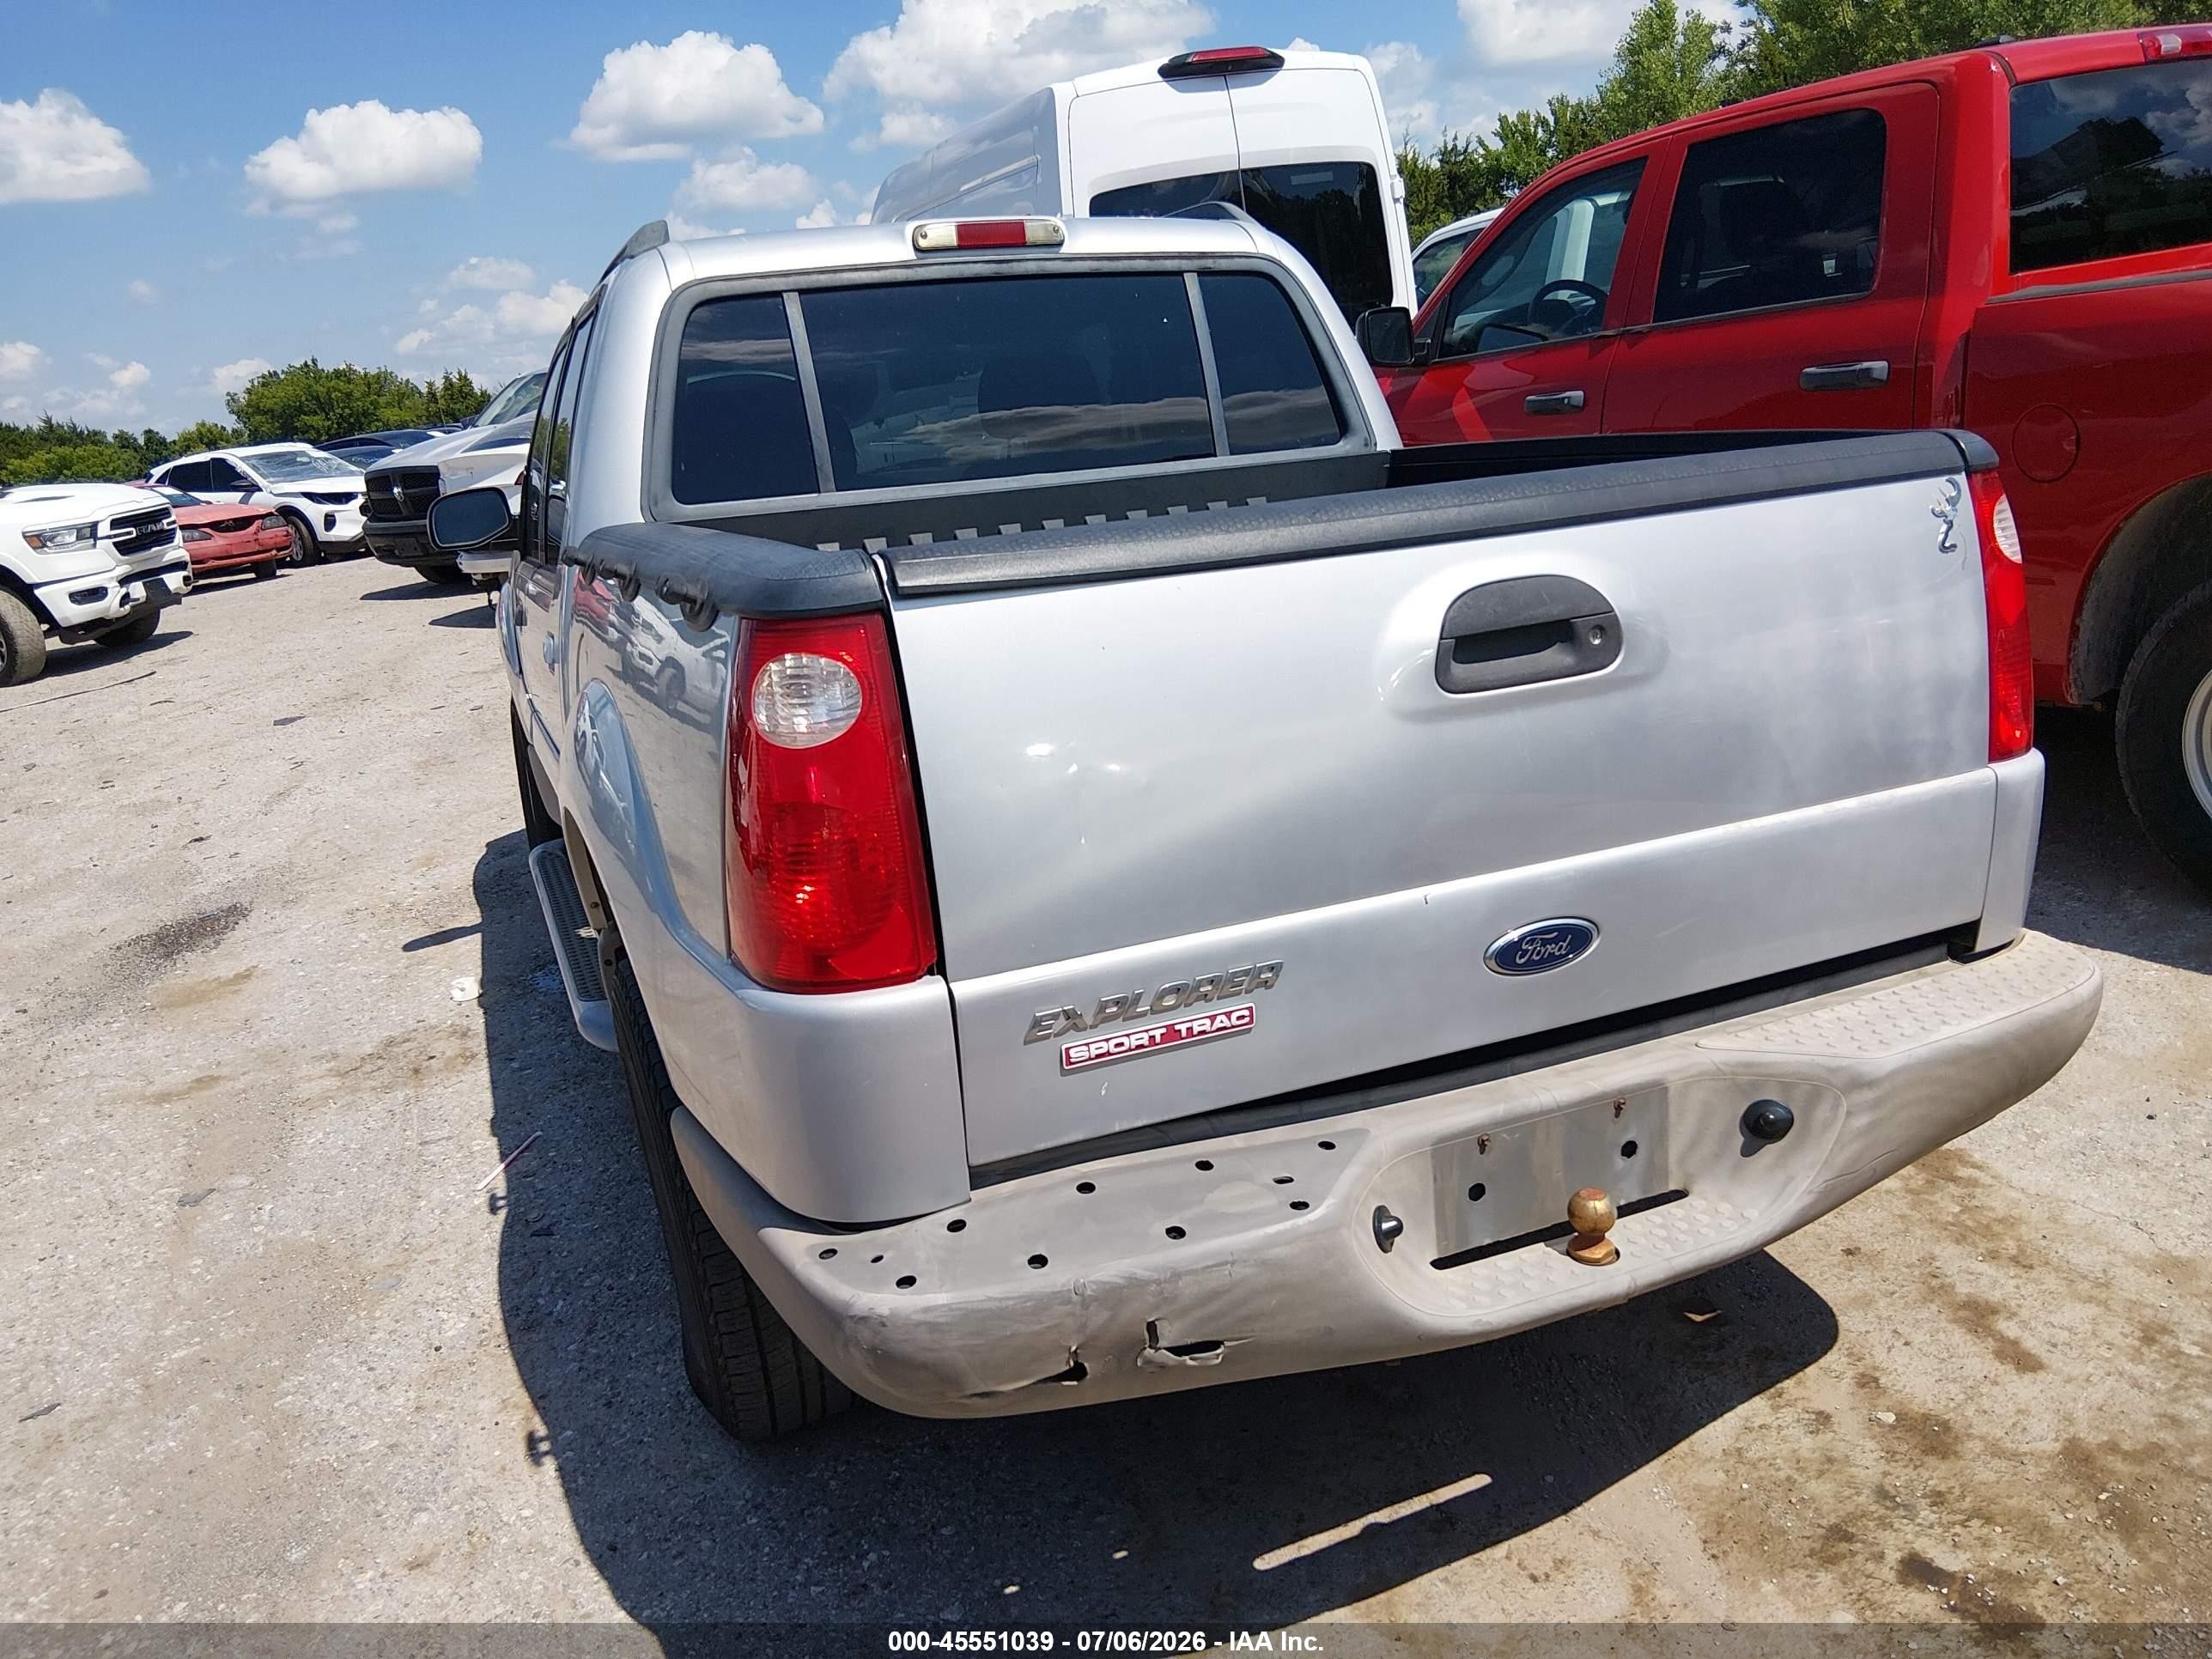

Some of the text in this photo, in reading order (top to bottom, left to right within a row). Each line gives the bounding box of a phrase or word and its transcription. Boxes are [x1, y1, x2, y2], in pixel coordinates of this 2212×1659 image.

[137, 522, 167, 535] RAM
[1516, 932, 1572, 964] Ford
[1024, 959, 1285, 1046] EXPLORER
[1068, 1008, 1251, 1063] SPORT TRAC
